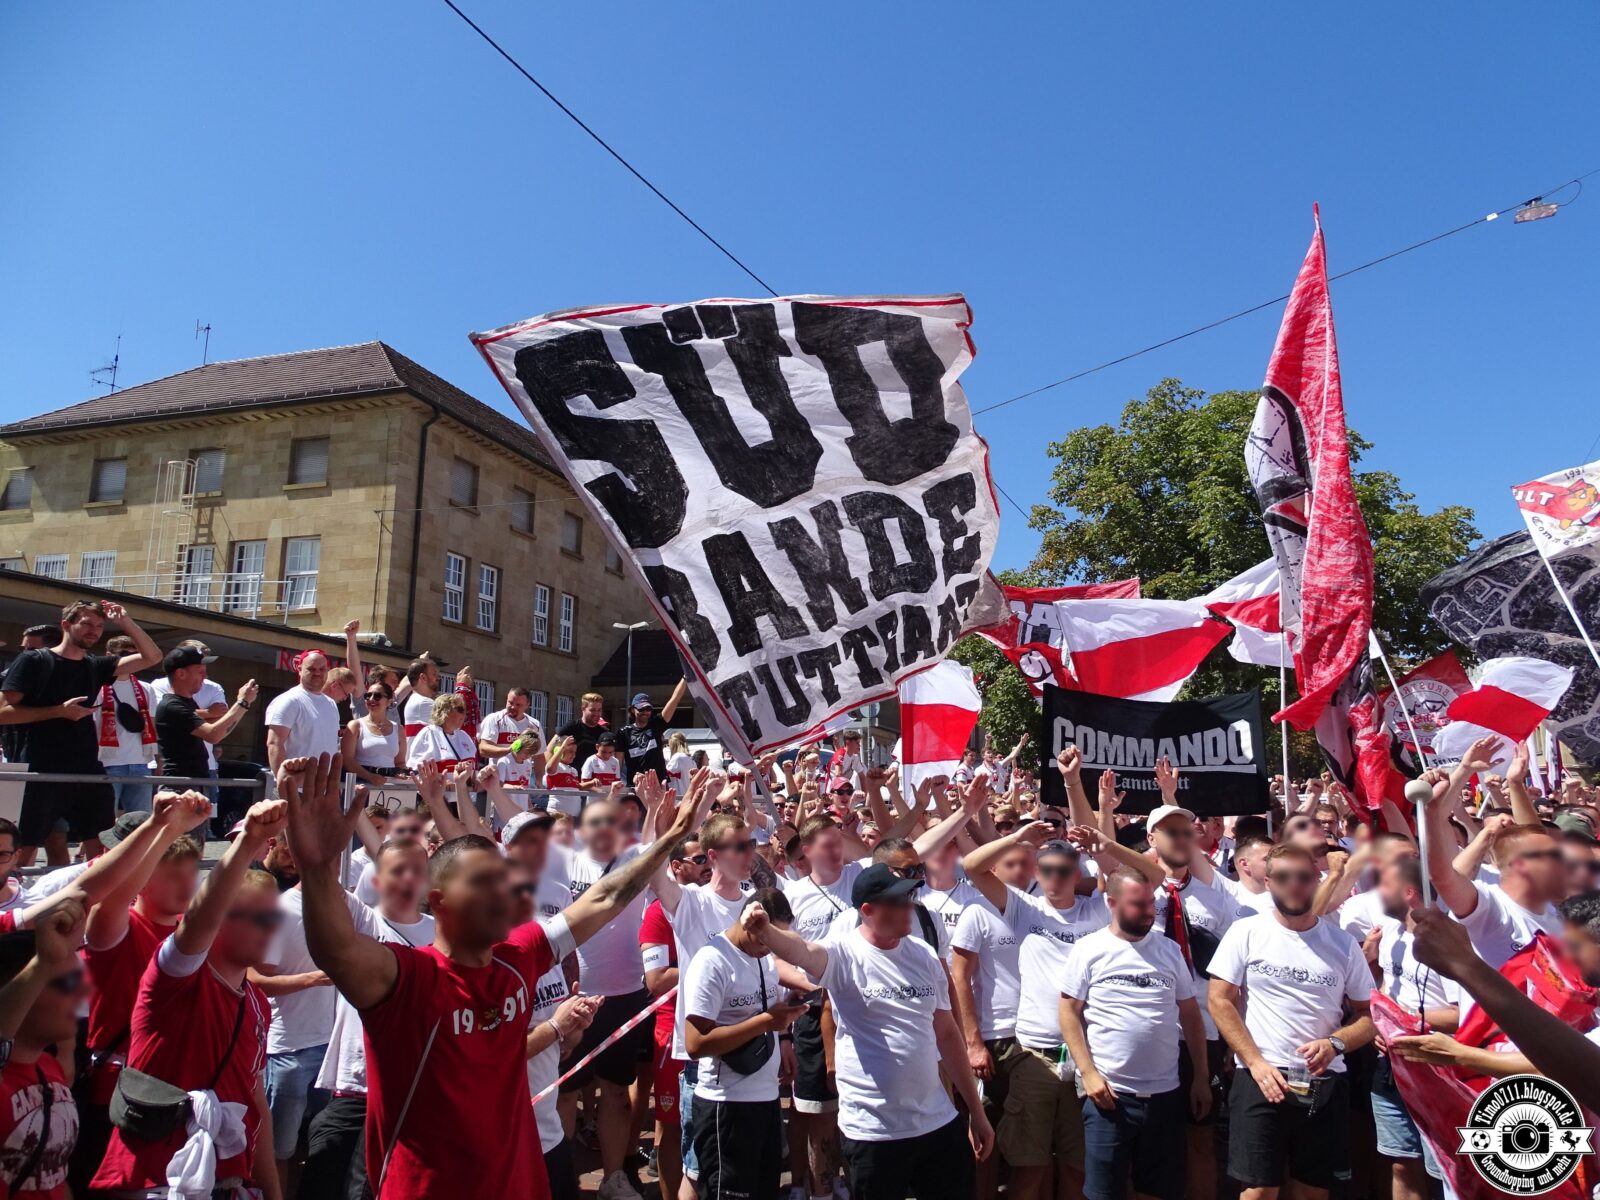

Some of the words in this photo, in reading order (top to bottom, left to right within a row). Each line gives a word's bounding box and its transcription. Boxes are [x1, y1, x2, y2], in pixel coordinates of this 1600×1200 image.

[514, 300, 960, 549] SÜD
[643, 472, 982, 673] BANDE
[1053, 716, 1253, 767] COMMANDO
[1113, 773, 1190, 791] Cannstt
